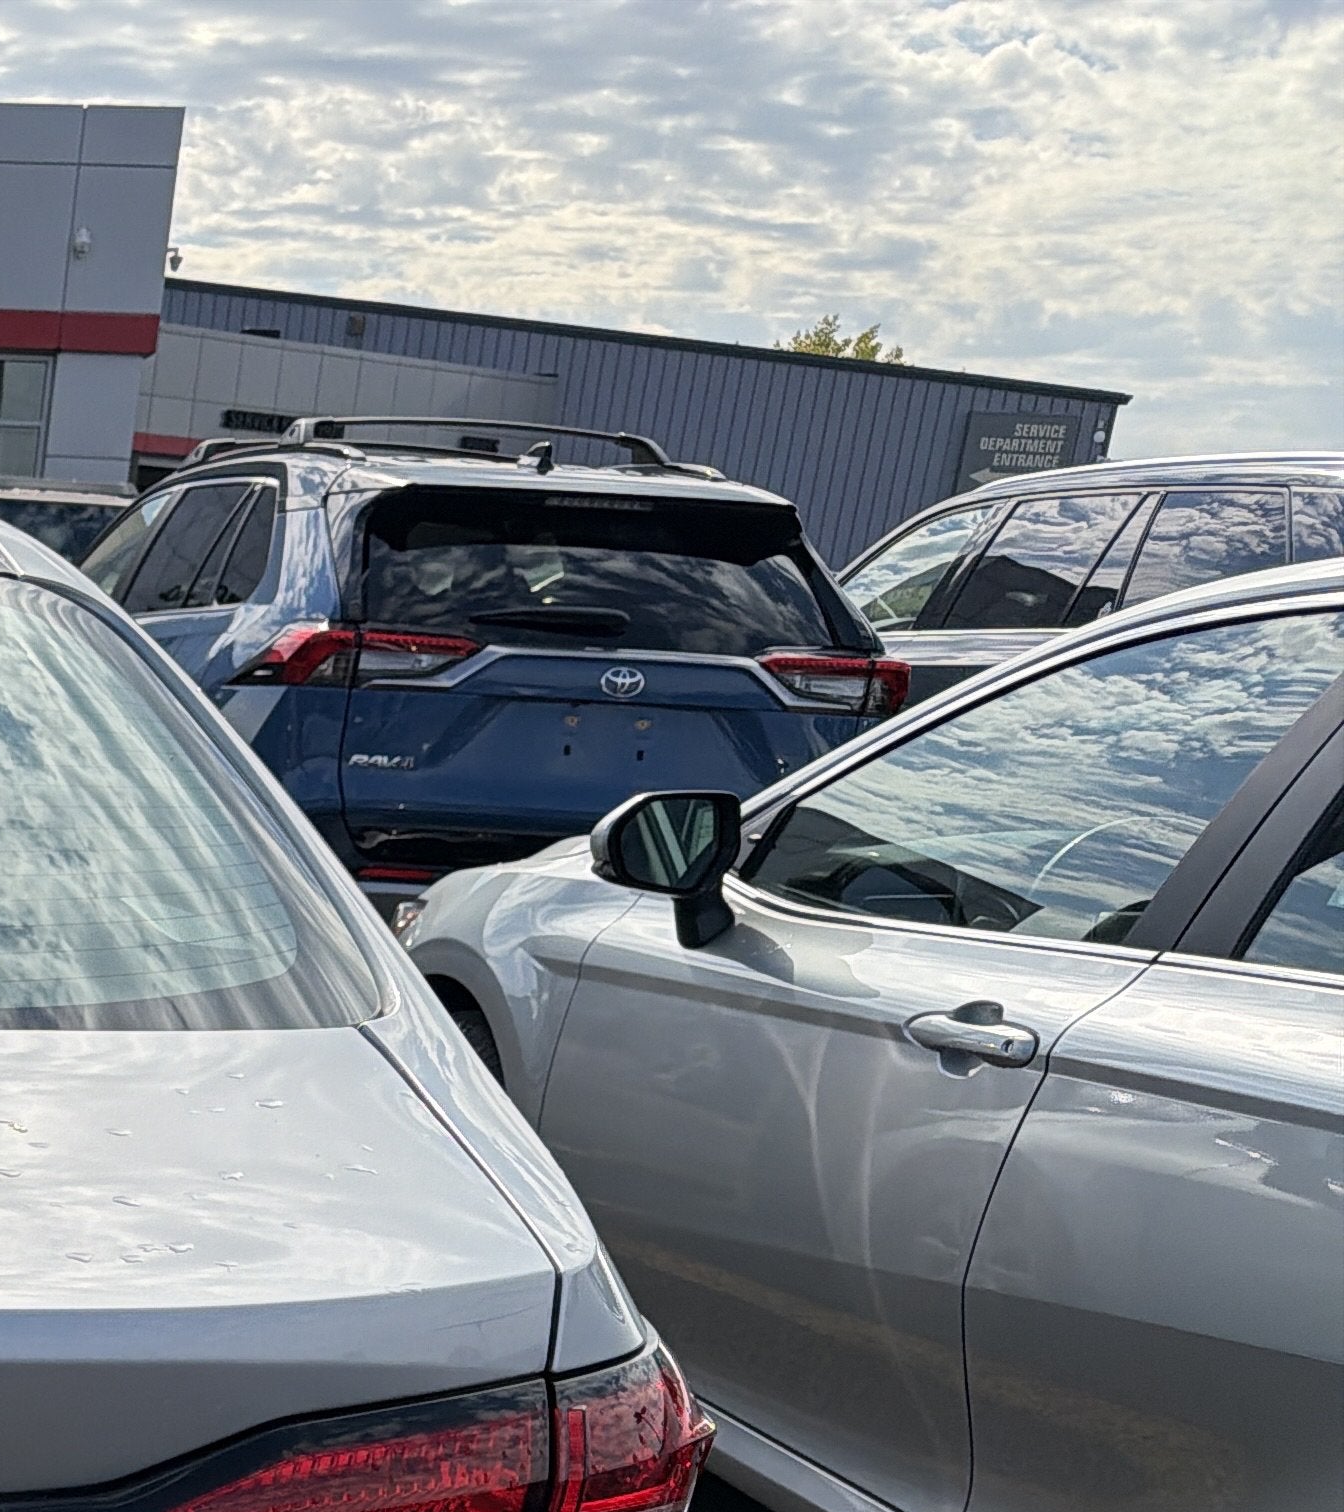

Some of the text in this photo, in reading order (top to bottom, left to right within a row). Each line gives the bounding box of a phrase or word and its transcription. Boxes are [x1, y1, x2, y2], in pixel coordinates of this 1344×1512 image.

[1014, 423, 1067, 438] SERVICE
[979, 437, 1064, 453] DEPARTMENT
[993, 453, 1060, 468] ENTRANCE
[348, 754, 415, 769] RAV4
